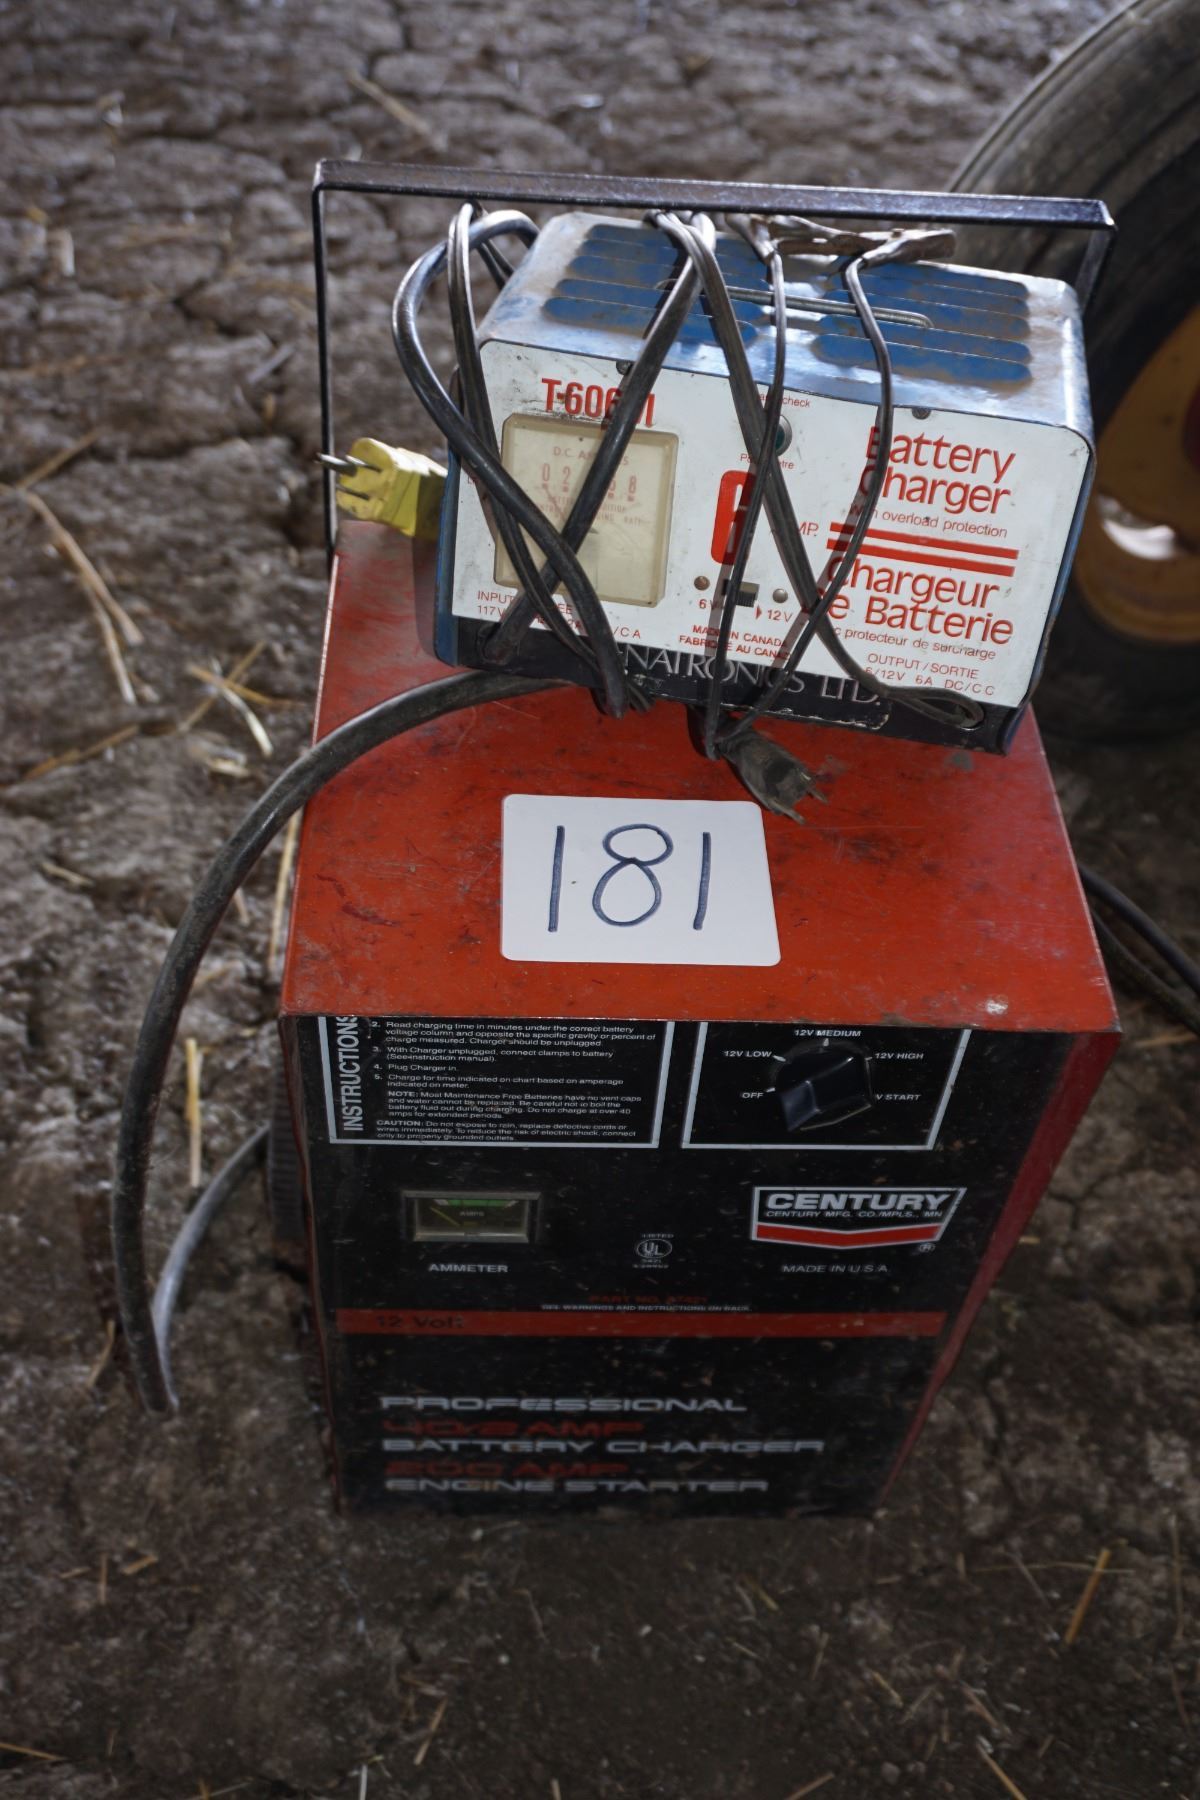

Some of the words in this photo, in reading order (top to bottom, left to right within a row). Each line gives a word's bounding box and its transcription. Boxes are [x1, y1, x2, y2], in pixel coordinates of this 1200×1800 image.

[882, 511, 938, 528] overload
[943, 520, 1007, 538] protection
[827, 556, 999, 608] Chargeur
[865, 596, 1013, 644] Batterie
[845, 628, 908, 646] protecteur
[913, 638, 929, 649] de
[736, 644, 751, 654] AU
[548, 823, 711, 932] 181
[414, 1022, 452, 1030] charging
[603, 1026, 634, 1034] battery
[386, 1036, 418, 1044] charge
[746, 1050, 772, 1058] LOW
[896, 1052, 924, 1060] HIGH
[410, 1064, 446, 1072] Charger
[388, 1074, 422, 1082] Charge
[766, 1193, 952, 1210] CENTURY
[766, 1210, 821, 1218] CENTURY
[644, 1242, 664, 1256] UL
[428, 1264, 508, 1272] AMMETER
[380, 1396, 748, 1412] PROFESSIONAL
[526, 1420, 646, 1438] AMP
[382, 1438, 594, 1452] BATTERY
[606, 1440, 824, 1453] CHARGER
[512, 1460, 629, 1478] AMP
[385, 1479, 554, 1492] ENGINE
[565, 1480, 768, 1492] STARTER
